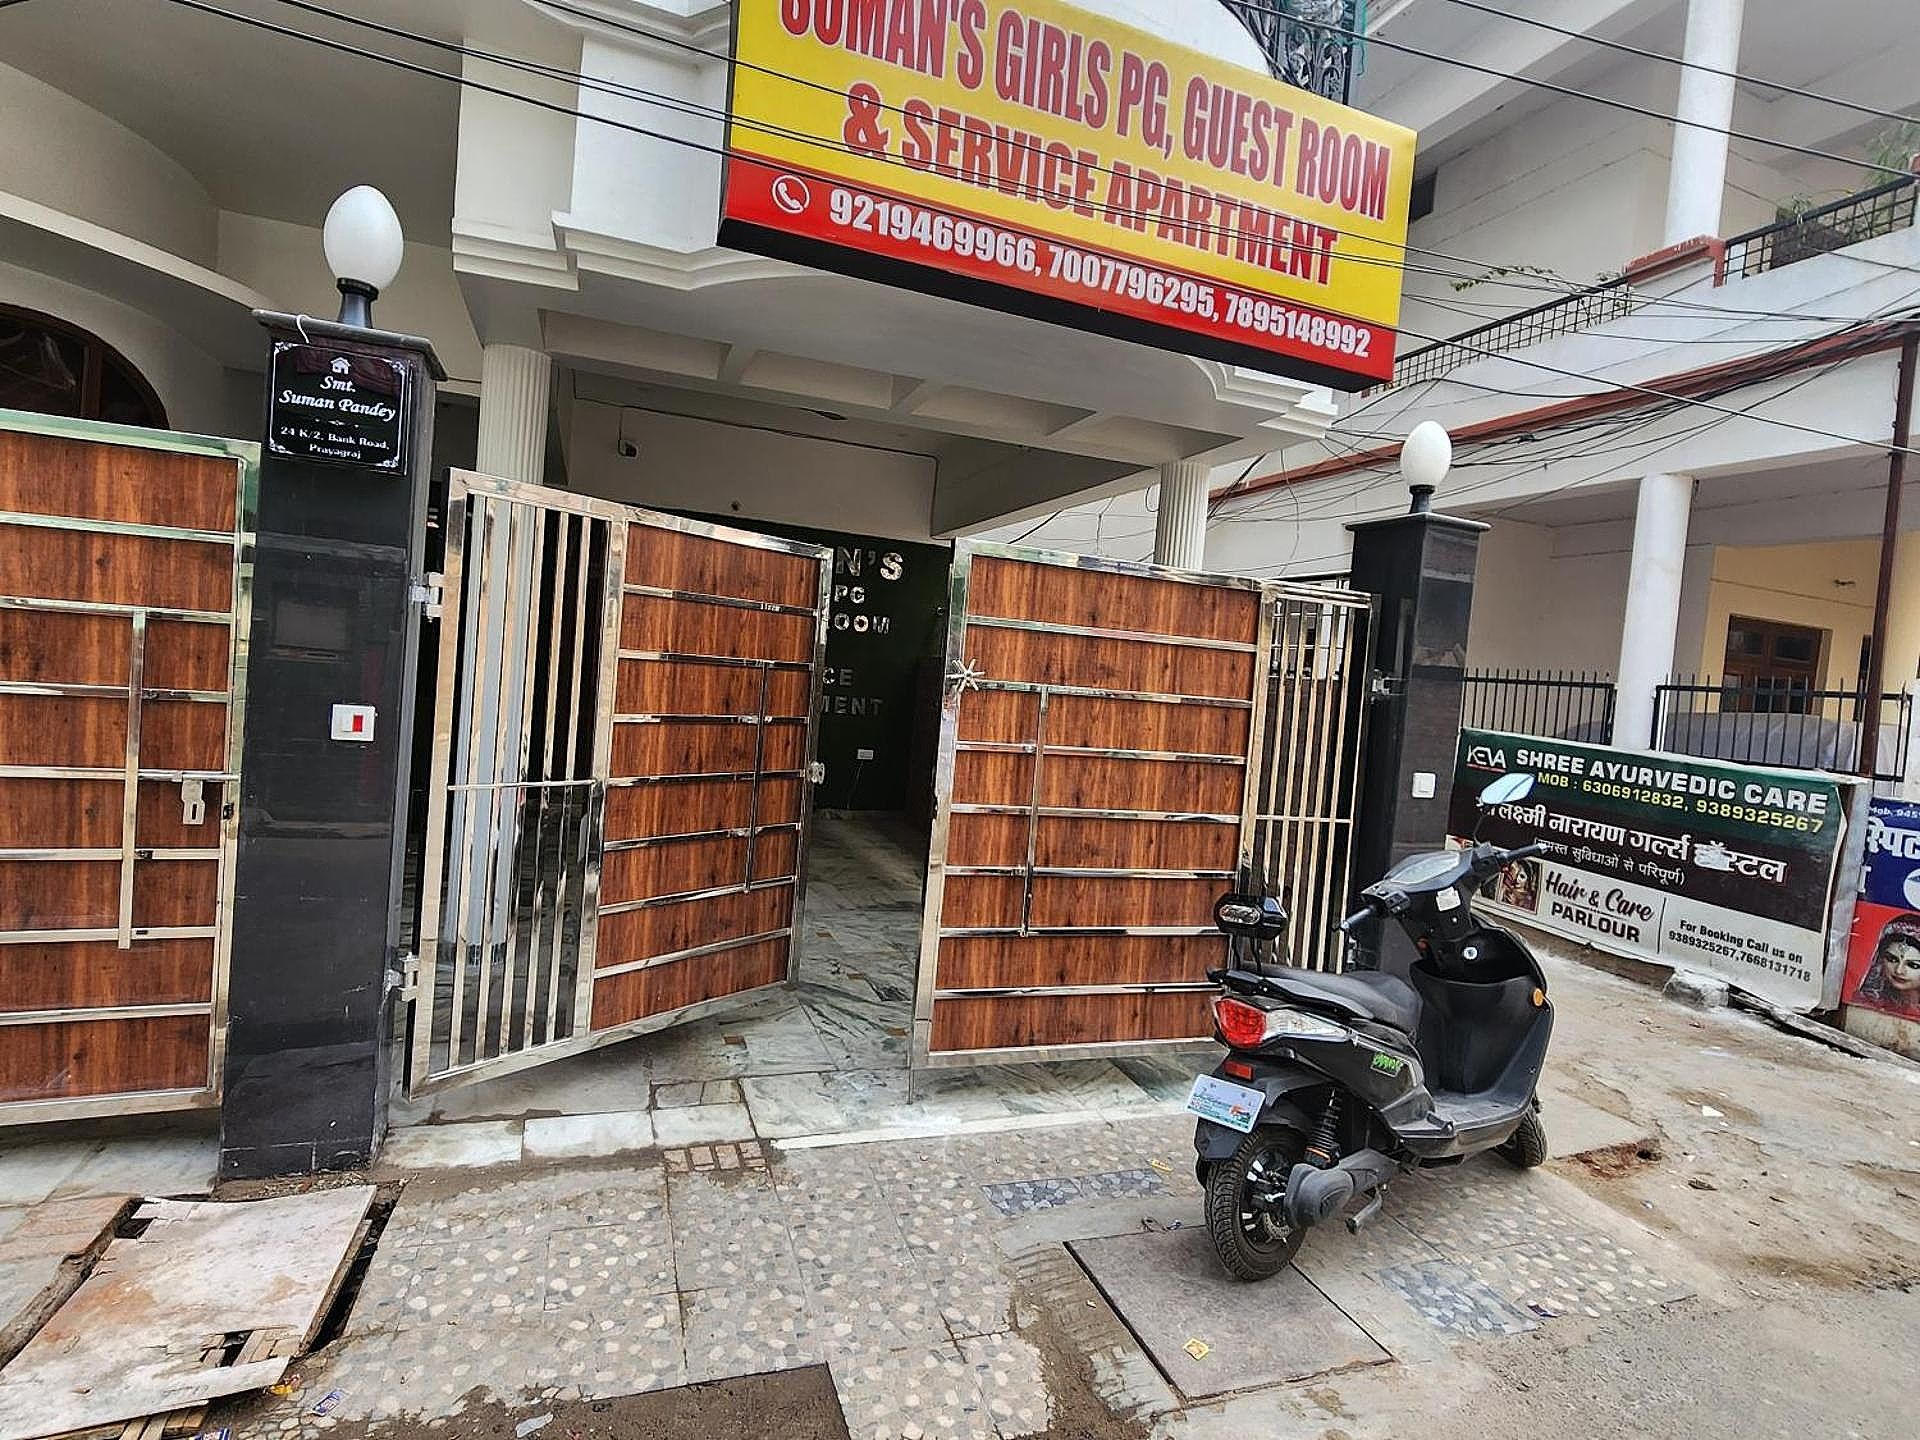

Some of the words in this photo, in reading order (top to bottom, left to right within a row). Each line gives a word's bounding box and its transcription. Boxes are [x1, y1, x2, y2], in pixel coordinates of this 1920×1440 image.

[995, 10, 1109, 130] GIRLS
[1118, 49, 1171, 161] PG,
[1184, 76, 1293, 187] GUEST
[1302, 119, 1389, 222] ROOM
[843, 82, 889, 161] &
[902, 98, 1096, 217] SERVICE
[1103, 163, 1339, 287] APARTMENT
[829, 188, 1042, 277] 9219469966,
[1048, 245, 1220, 322] 7007796295,
[1225, 293, 1370, 359] 7895148992
[279, 389, 335, 410] Suman
[339, 399, 396, 422] Pandey
[320, 375, 357, 393] Smt.
[280, 426, 296, 436] 24
[328, 433, 356, 446] Bank
[309, 443, 362, 460] Prayagraj
[1516, 749, 1585, 775] SHREE
[1590, 760, 1736, 800] AYURVEDIC
[1744, 783, 1828, 814] CARE
[1538, 772, 1569, 787] MOB
[1696, 799, 1824, 833] 9389325267
[1549, 812, 1627, 847] नारायण
[1545, 870, 1587, 901] Hair
[1588, 889, 1600, 908] &
[1605, 888, 1656, 922] Care
[1551, 901, 1641, 943] PARLOUR
[1680, 919, 1697, 933] For
[1700, 924, 1744, 948] Booking
[1746, 938, 1769, 953] Call
[1772, 947, 1785, 959] us
[1788, 953, 1803, 964] on
